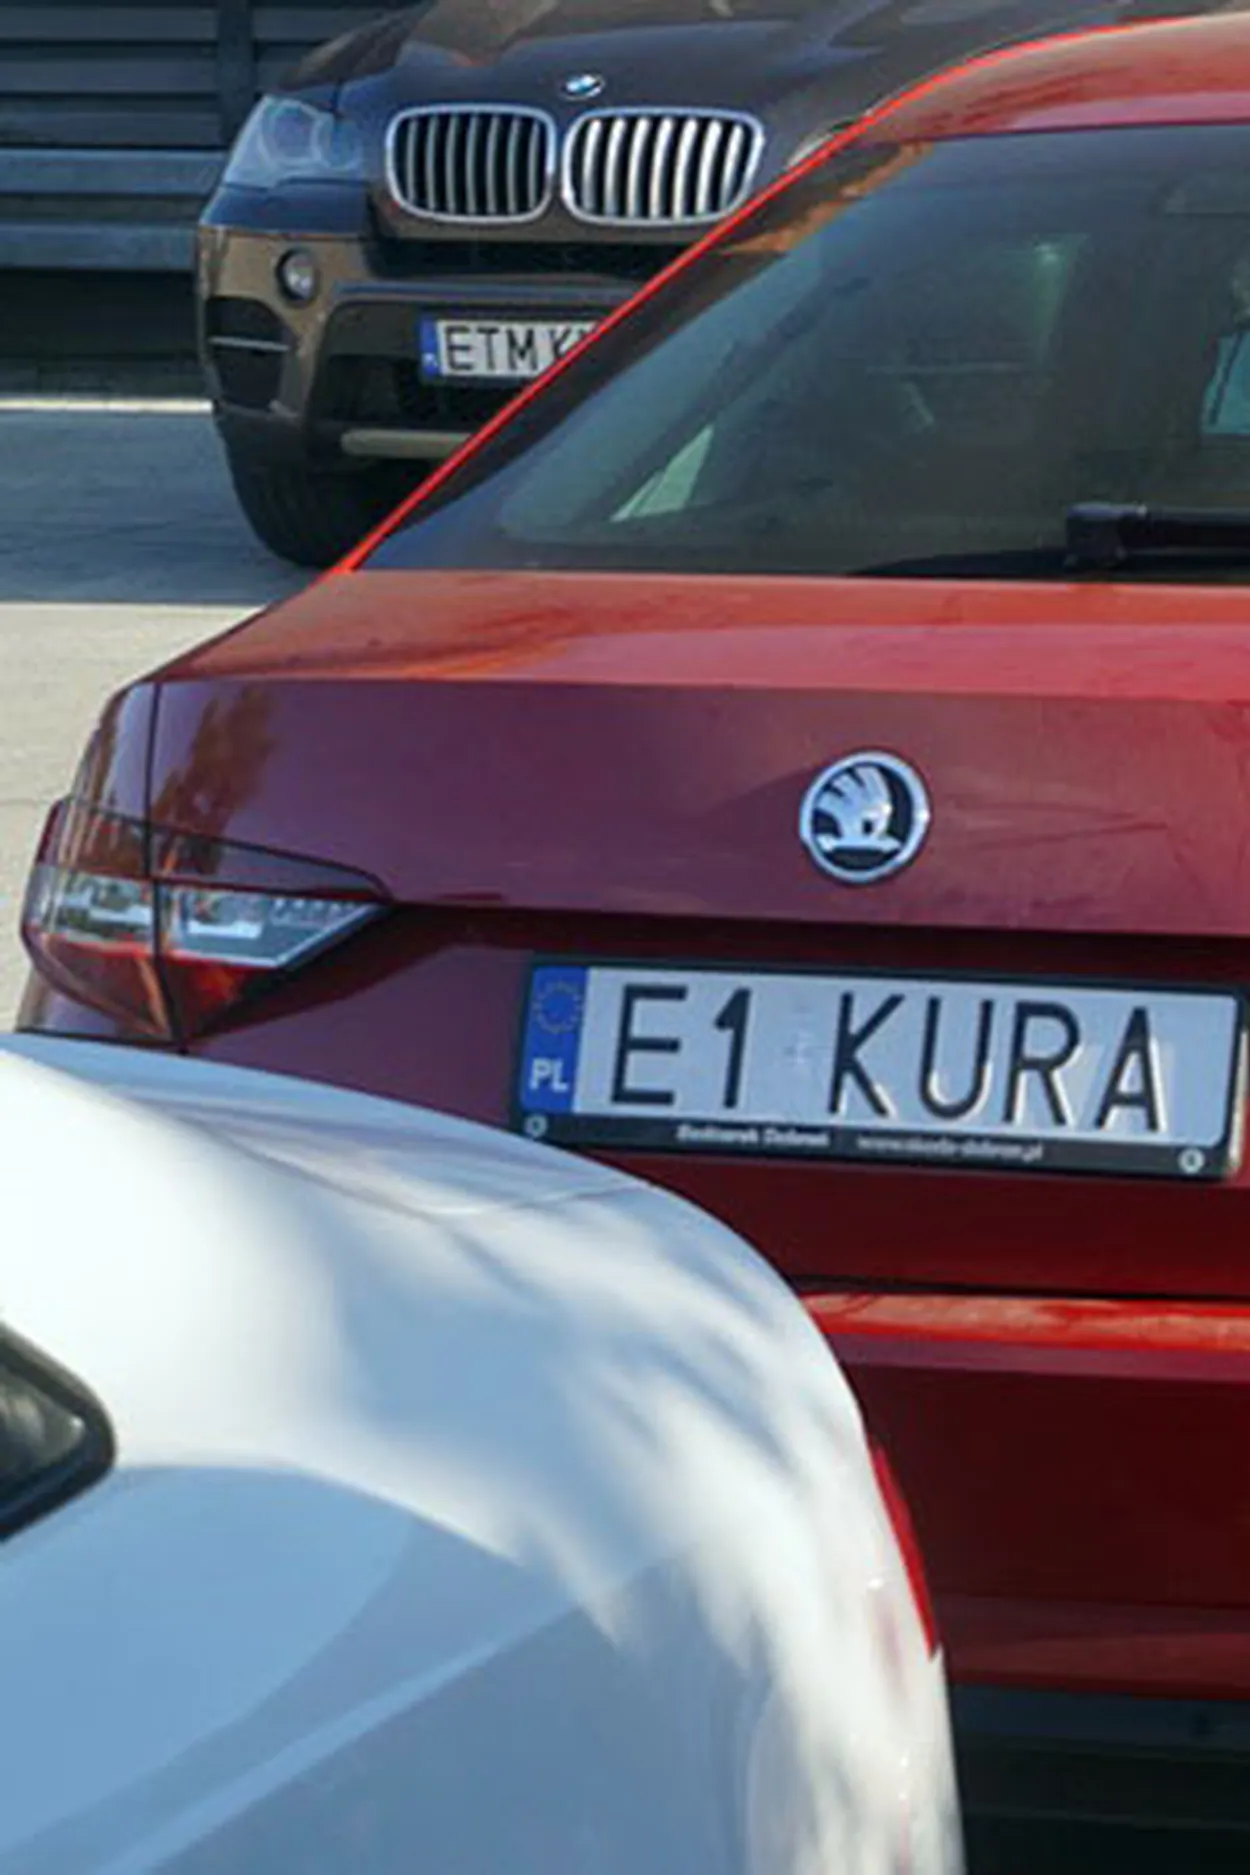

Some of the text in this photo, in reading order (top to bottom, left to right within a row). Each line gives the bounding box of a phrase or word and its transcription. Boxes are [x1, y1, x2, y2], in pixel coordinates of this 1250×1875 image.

[445, 325, 538, 372] ETM
[529, 1058, 568, 1091] PL
[611, 983, 1161, 1132] E1 KURA
